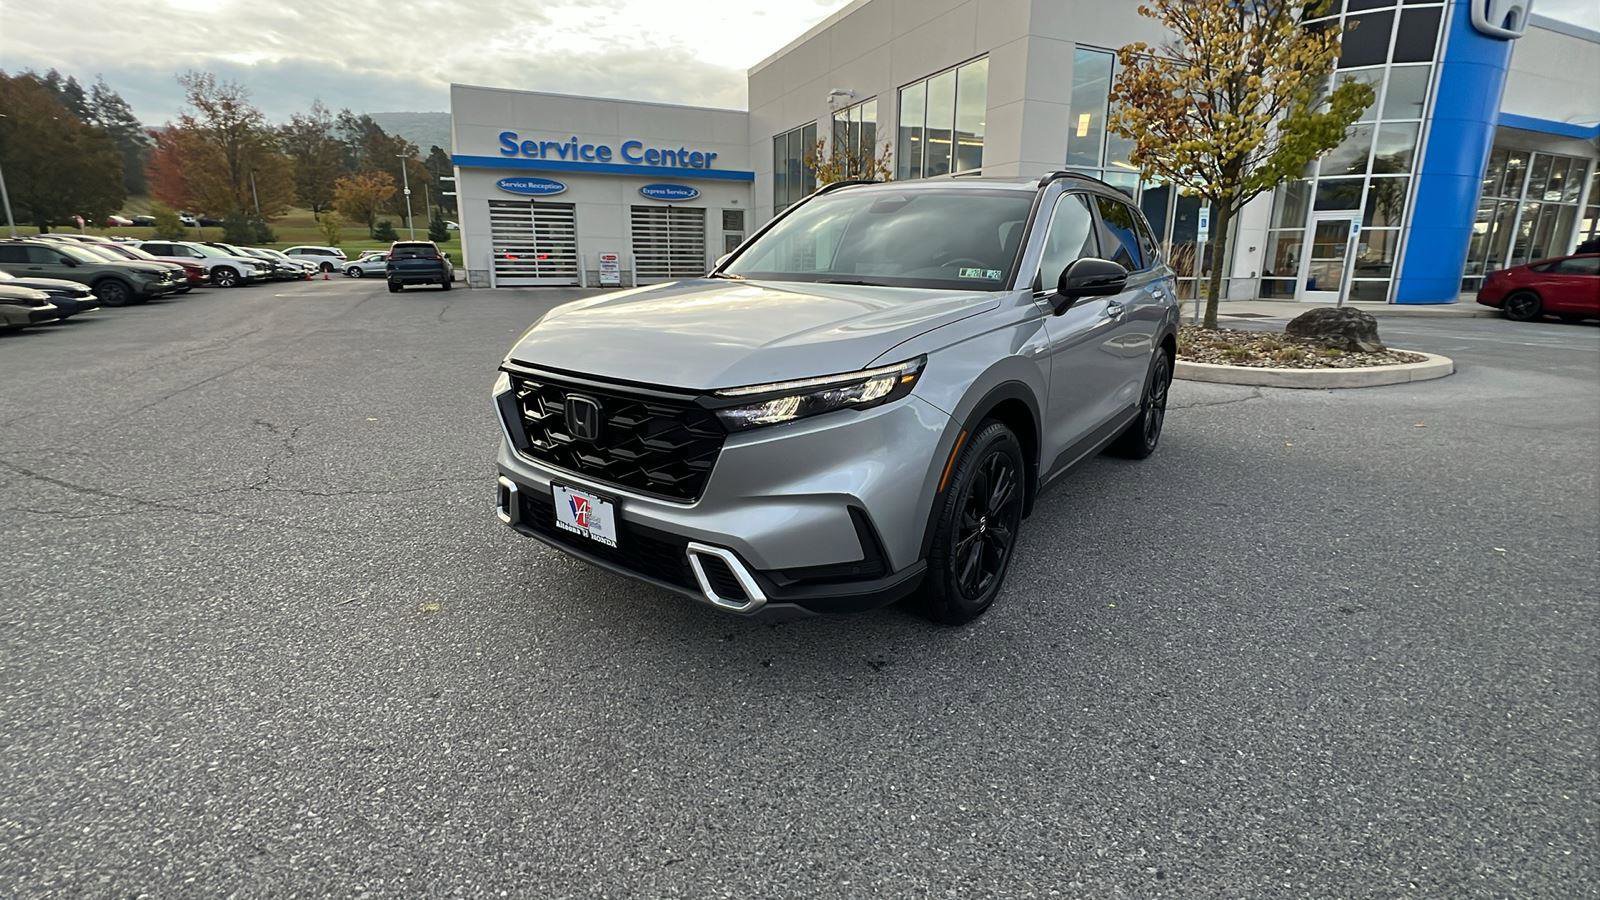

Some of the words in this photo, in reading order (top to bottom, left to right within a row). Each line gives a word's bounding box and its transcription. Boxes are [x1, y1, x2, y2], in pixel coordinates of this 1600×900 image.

[499, 131, 612, 163] Service
[621, 140, 718, 168] Center
[500, 181, 528, 189] Service
[529, 182, 562, 191] Reception
[643, 187, 666, 195] Express
[667, 188, 688, 196] Service
[591, 533, 618, 548] HONDA
